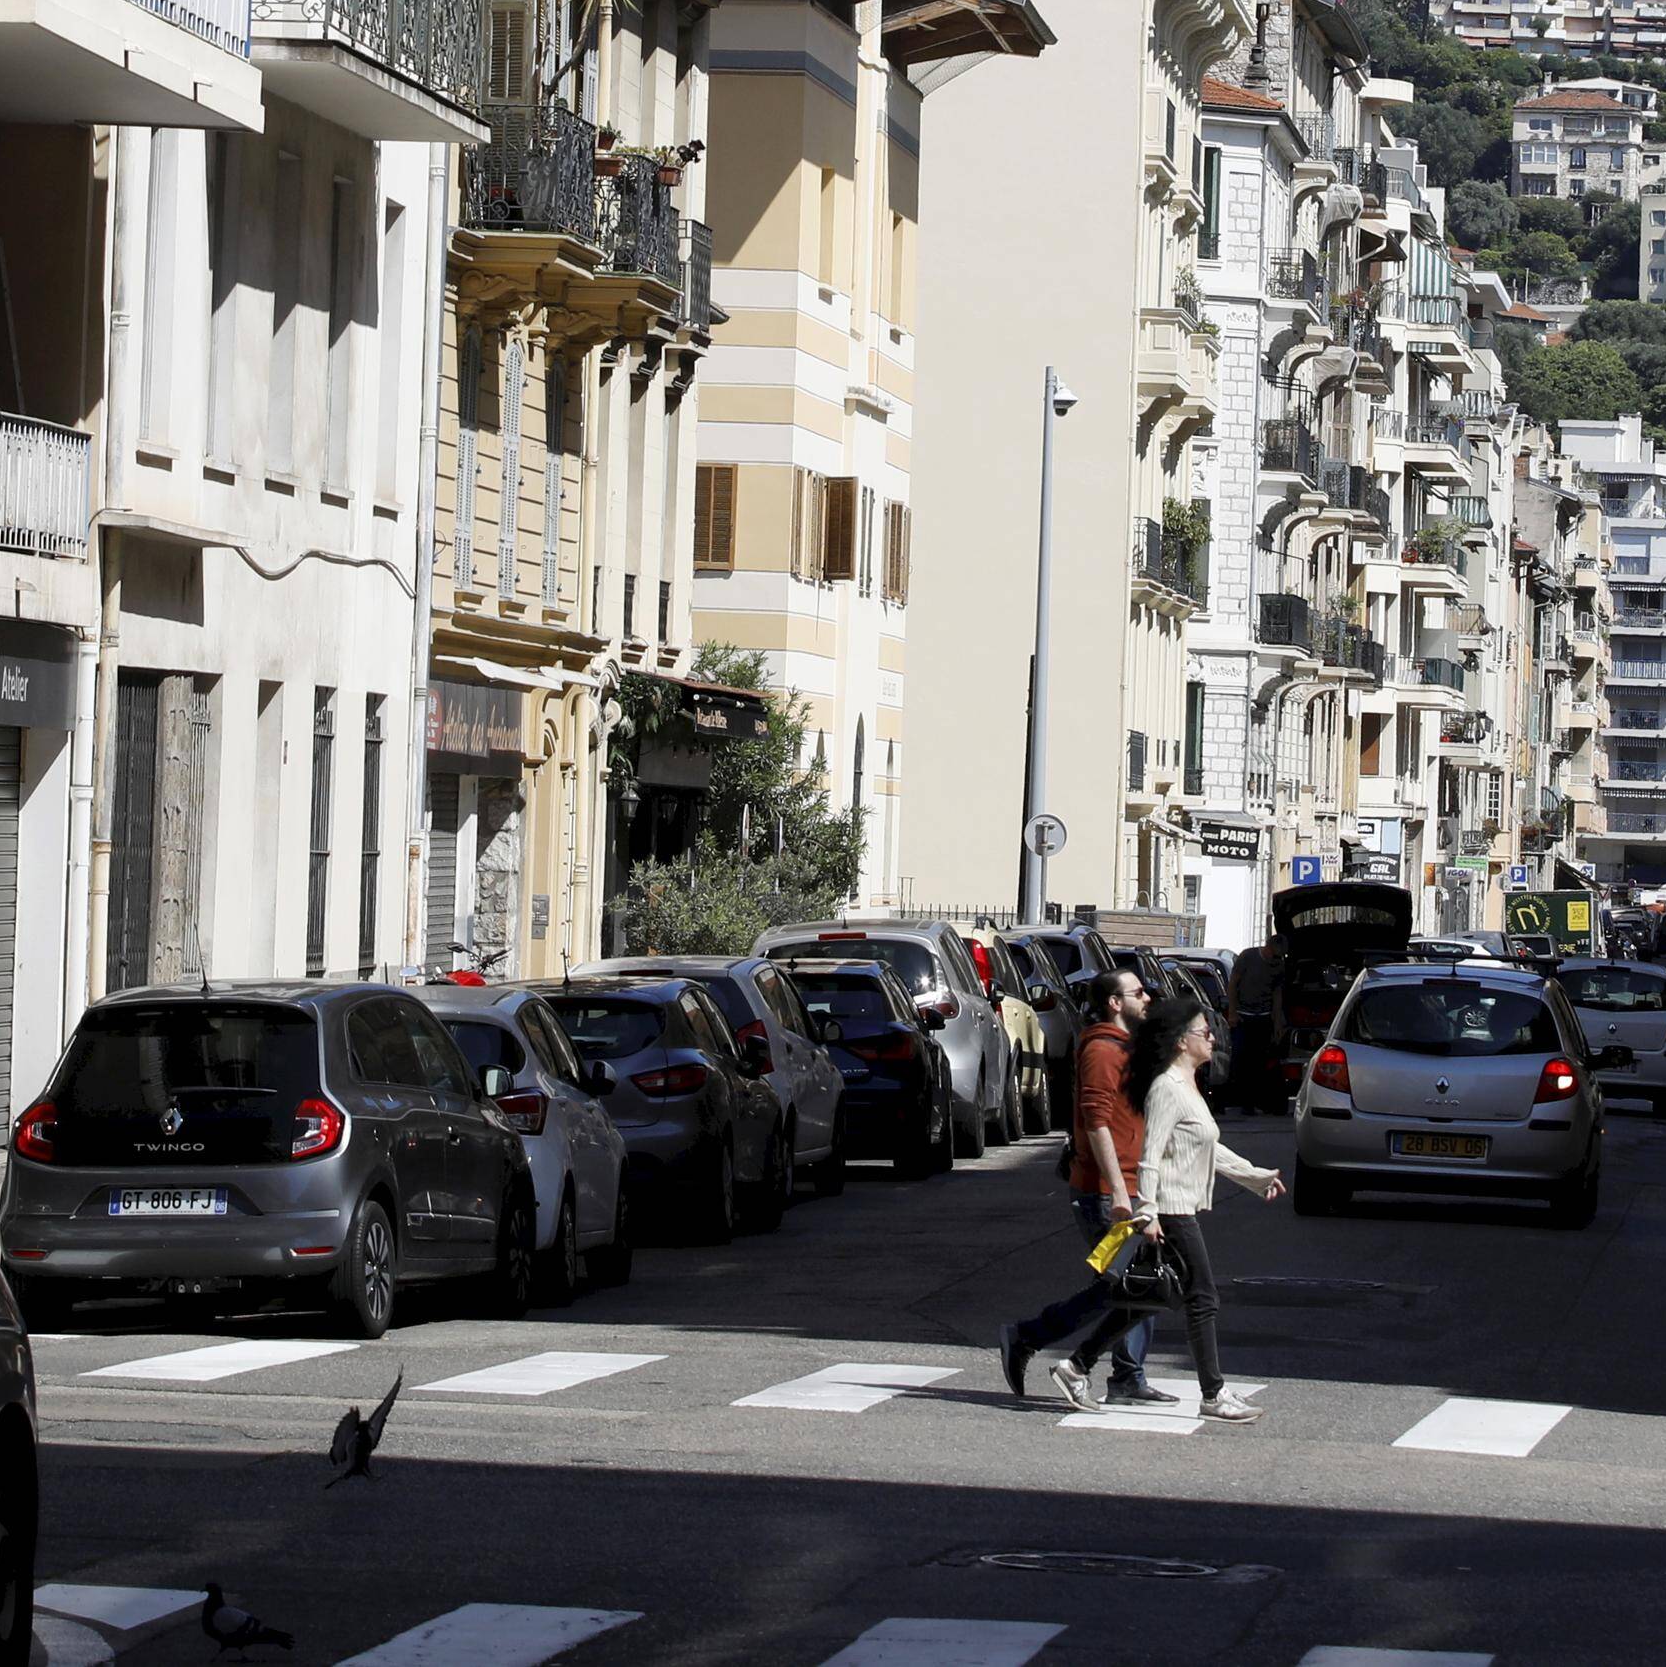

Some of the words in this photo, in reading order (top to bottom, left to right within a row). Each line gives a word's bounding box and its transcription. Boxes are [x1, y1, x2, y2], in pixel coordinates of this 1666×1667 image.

[1, 665, 29, 702] Atelier
[1220, 829, 1257, 844] PARIS
[1207, 844, 1250, 857] MOTO
[1299, 861, 1313, 880] P
[1447, 869, 1469, 877] IGOL
[1513, 868, 1523, 880] P
[133, 1142, 205, 1152] TWINGO
[1405, 1136, 1424, 1152] 28
